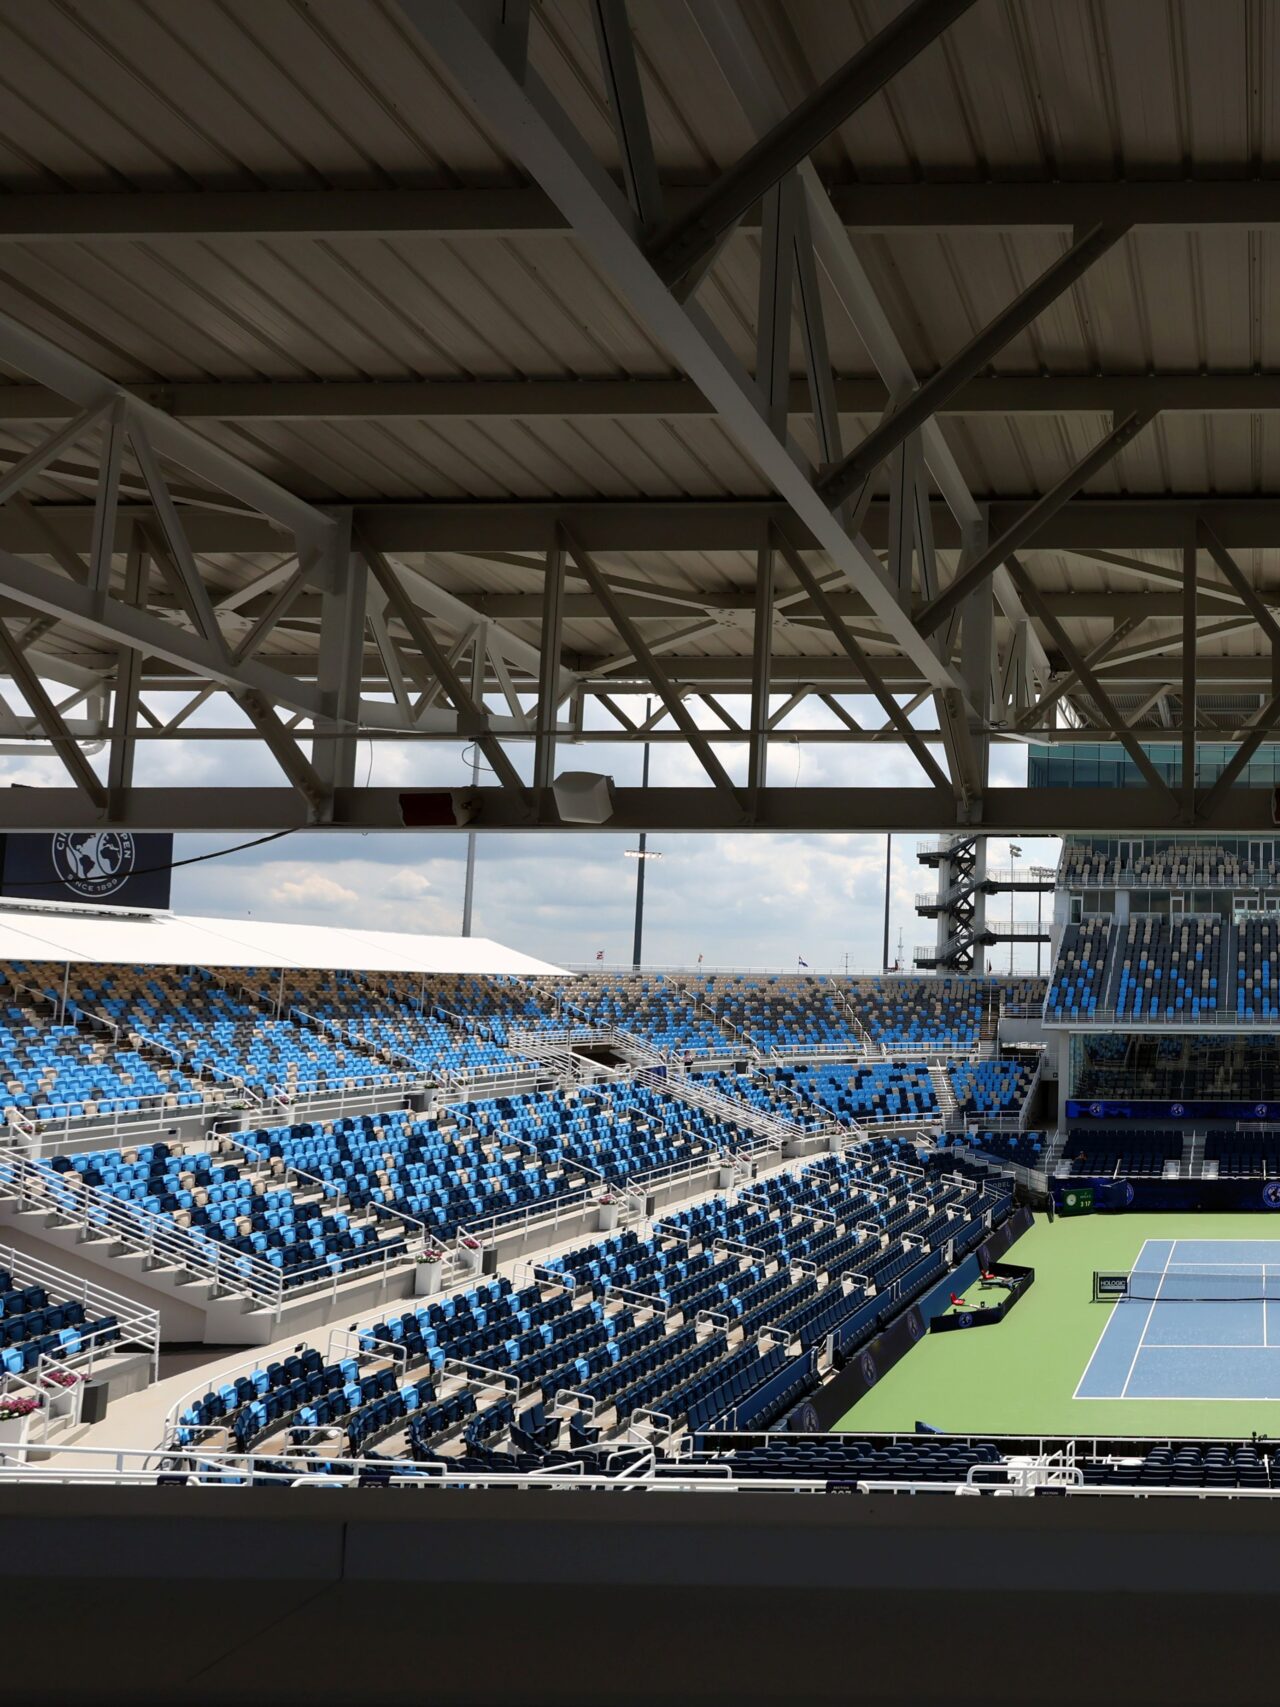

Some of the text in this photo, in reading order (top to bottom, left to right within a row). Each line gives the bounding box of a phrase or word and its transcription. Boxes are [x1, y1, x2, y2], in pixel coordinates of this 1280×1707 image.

[120, 833, 132, 859] PEN
[67, 873, 118, 892] SNCE 1899
